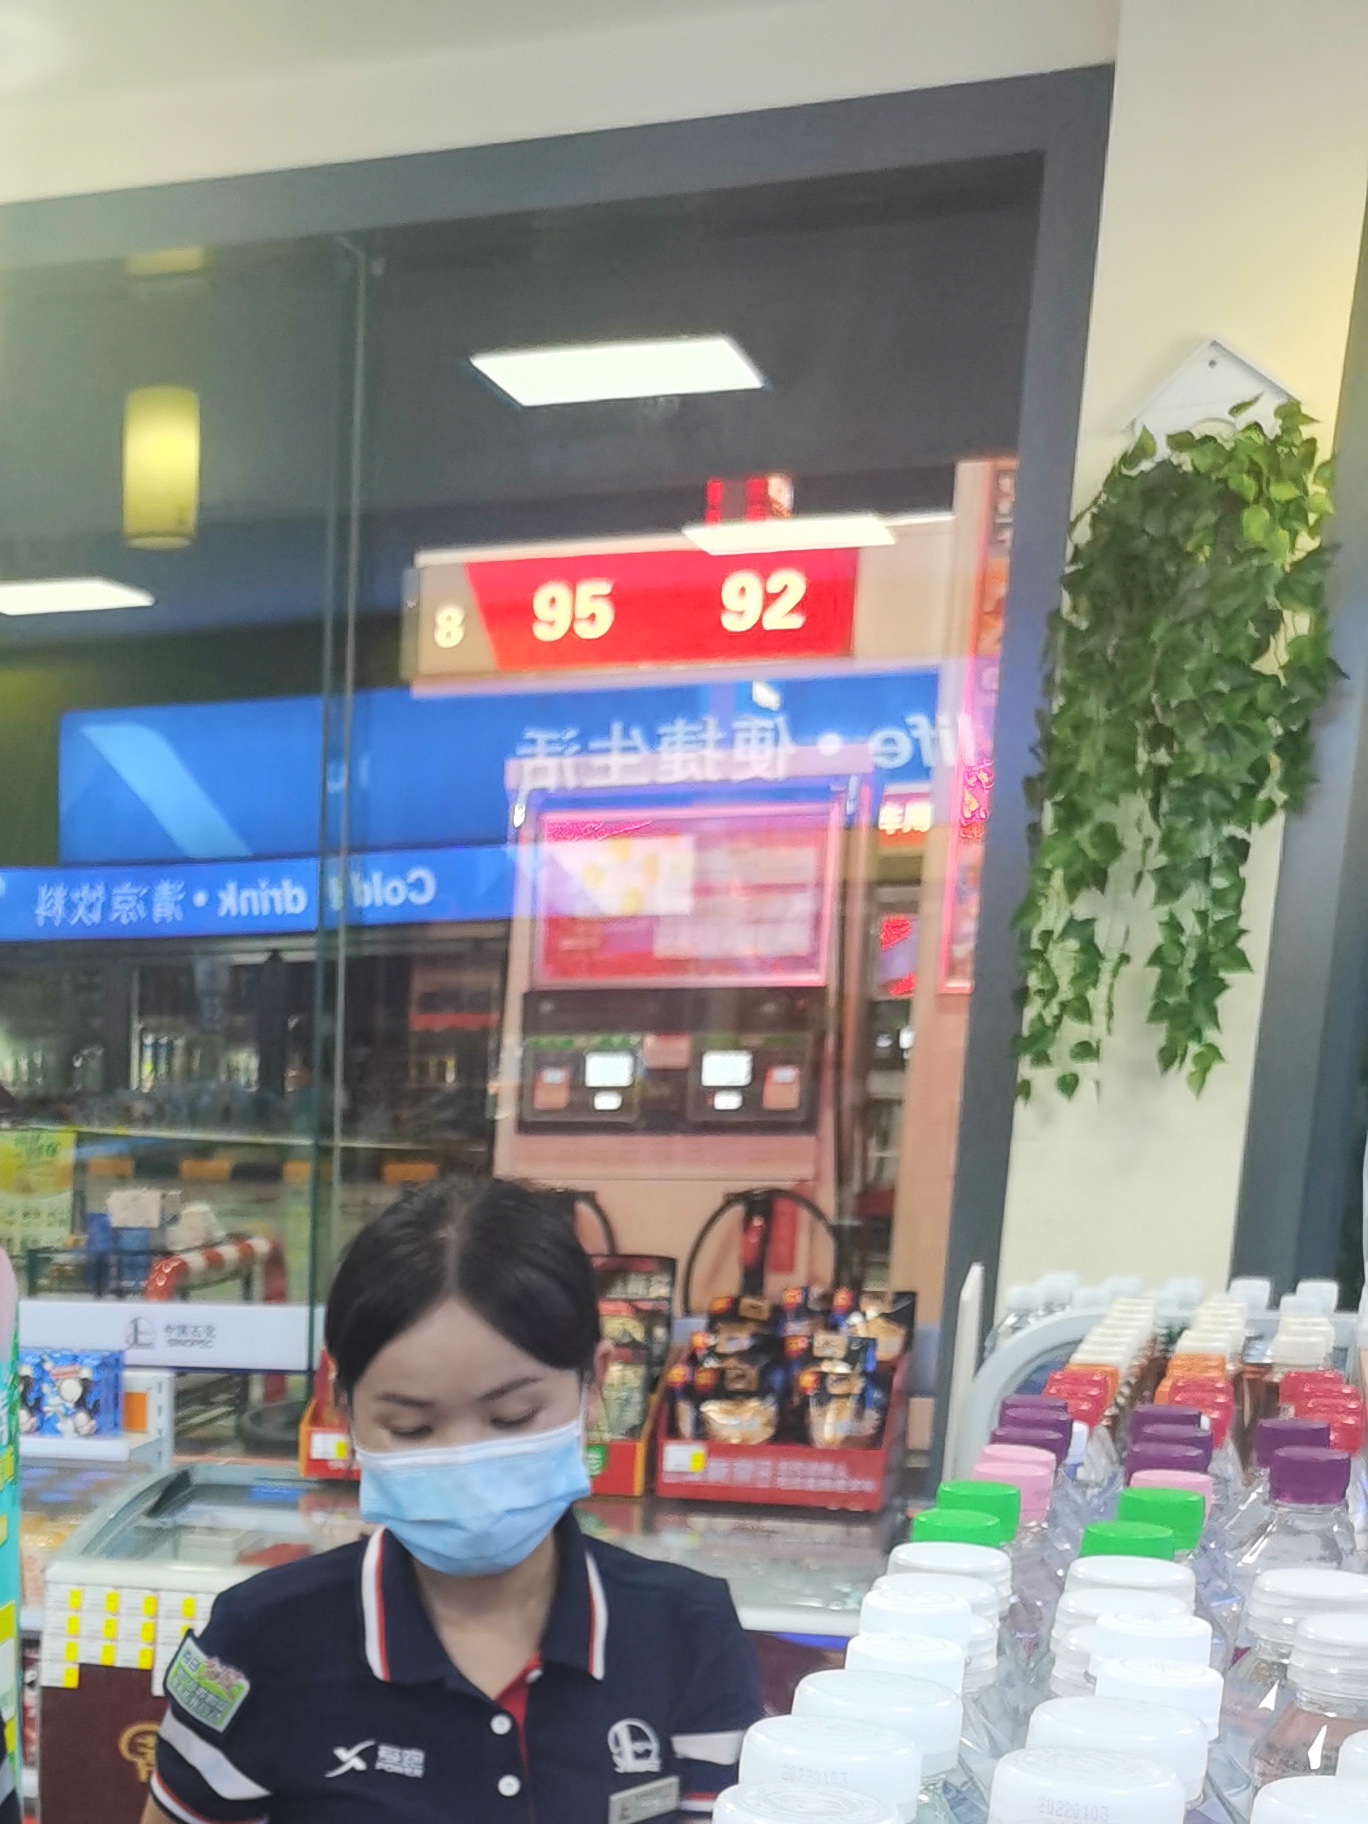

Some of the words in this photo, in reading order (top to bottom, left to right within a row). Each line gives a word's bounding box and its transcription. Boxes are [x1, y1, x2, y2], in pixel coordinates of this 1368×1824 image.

[433, 604, 465, 648] 8
[532, 579, 615, 641] 95
[720, 569, 807, 631] 92
